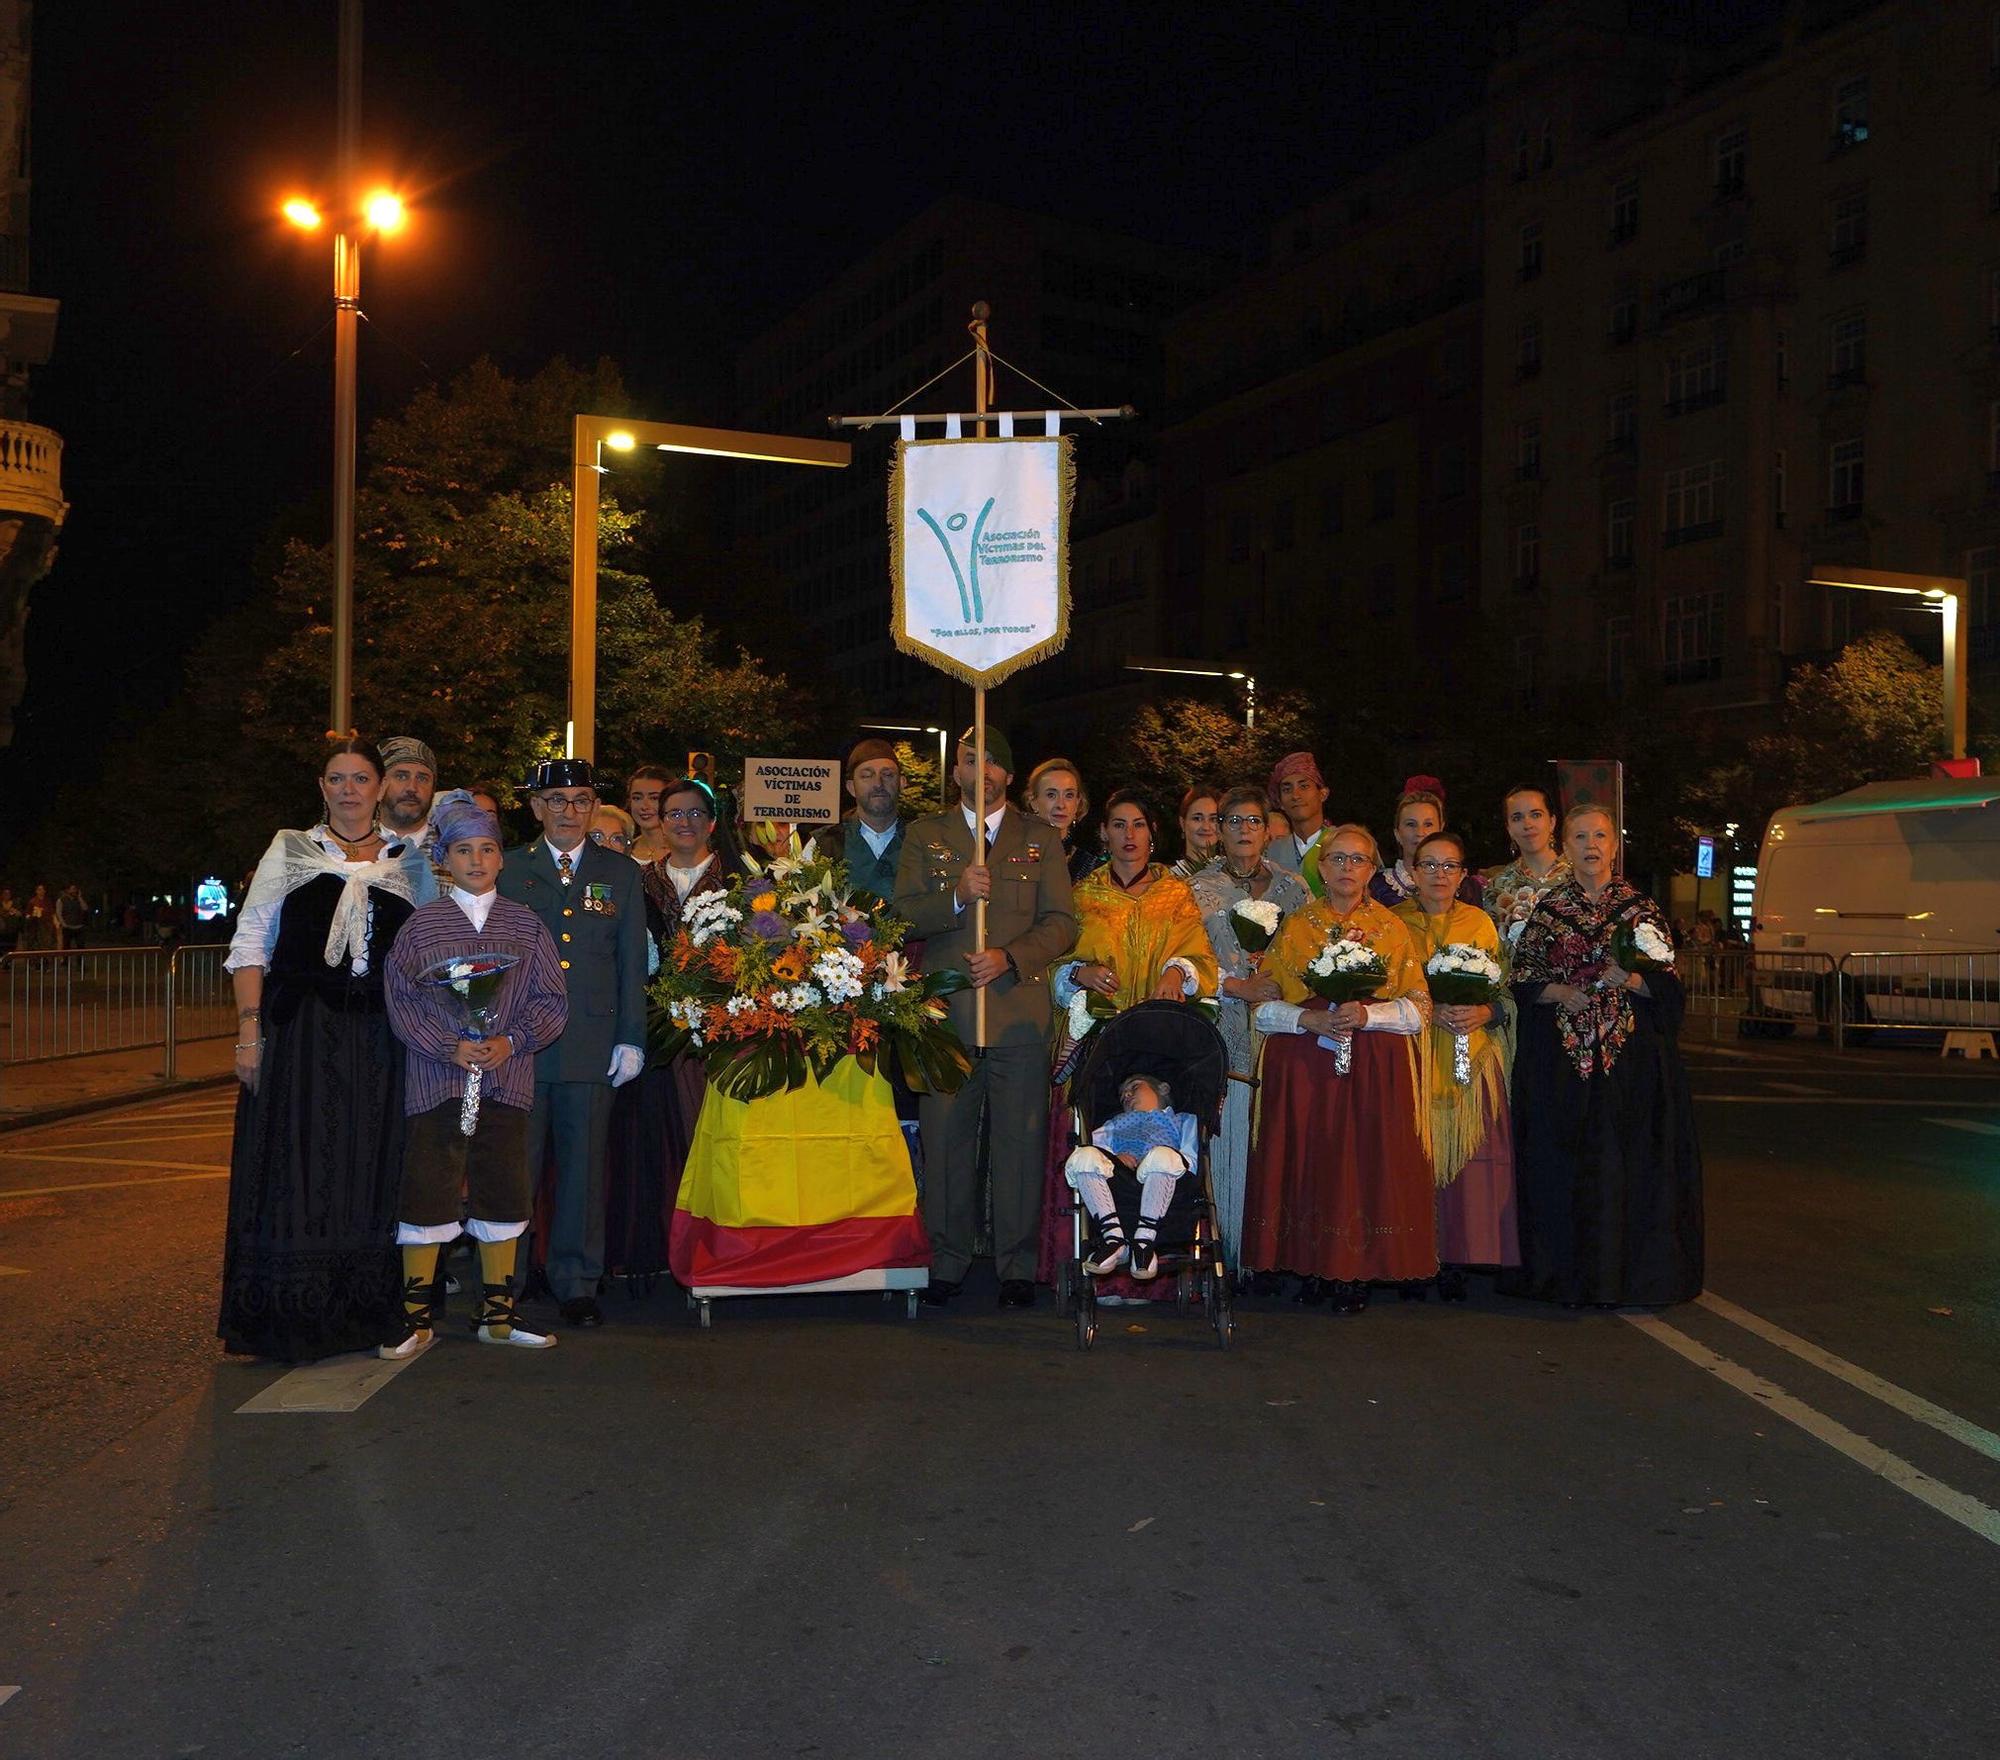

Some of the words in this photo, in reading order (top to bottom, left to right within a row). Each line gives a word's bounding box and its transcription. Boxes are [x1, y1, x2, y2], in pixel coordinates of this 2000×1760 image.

[755, 765, 831, 778] ASOCIACIÓN
[764, 778, 822, 791] VÍCTIMAS
[784, 794, 801, 805] DE
[753, 806, 831, 819] TERRORISMO
